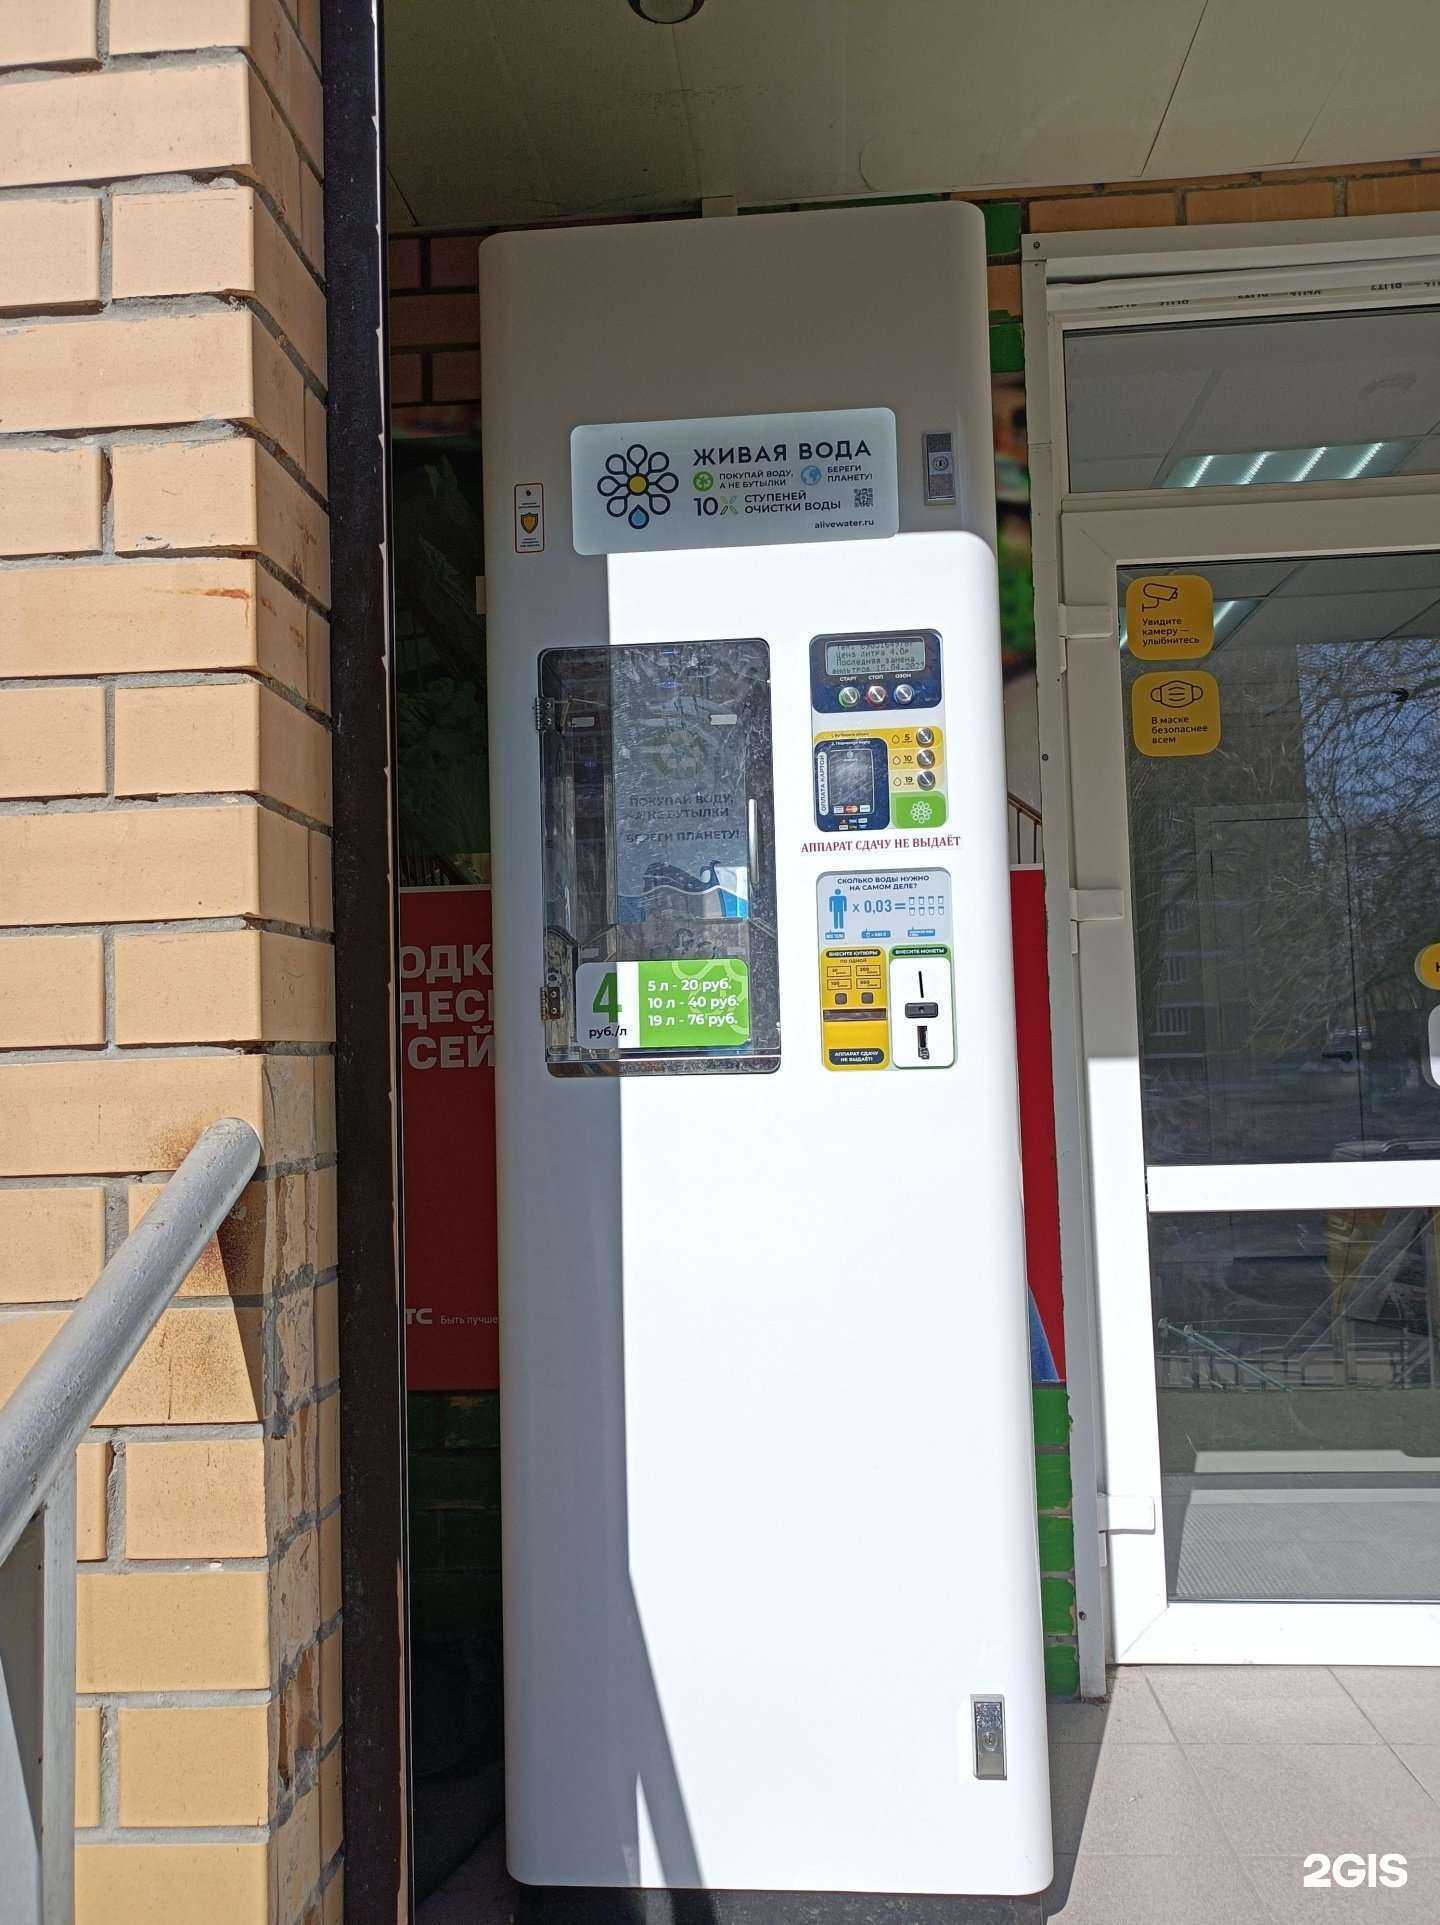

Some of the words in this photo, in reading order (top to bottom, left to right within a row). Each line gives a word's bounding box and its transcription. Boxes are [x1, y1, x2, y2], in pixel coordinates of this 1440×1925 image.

[693, 444, 787, 466] ЖИВАЯ
[799, 439, 871, 461] ВОДА
[719, 470, 764, 480] ПОКУПАЙ
[766, 469, 794, 479] ВОДУ,
[827, 464, 862, 474] БЕРЕГИ
[827, 473, 873, 483] ПЛАНЕТУ!
[728, 481, 741, 489] НЕ
[742, 479, 787, 488] БУТЫЛКИ
[744, 490, 807, 503] СТУПЕНЕЙ
[744, 501, 801, 514] ОЧИСТКИ
[804, 500, 841, 511] ВОДЫ
[814, 518, 875, 529] alivewater.ru
[1142, 618, 1182, 627] Увидите
[1142, 628, 1178, 637] камеру
[1142, 636, 1200, 647] улыбнитесь
[1151, 716, 1158, 724] В
[1160, 715, 1189, 724] маске
[1151, 725, 1208, 735] безопаснее
[904, 733, 910, 741] 5
[1152, 736, 1176, 744] всем
[676, 830, 740, 841] ПЛАНЕТУ!
[801, 840, 853, 853] АППАРАТ
[855, 839, 891, 851] СДАЧУ
[894, 838, 910, 849] НЕ
[912, 835, 961, 848] ВЫДАЁТ
[837, 877, 874, 885] СКОЛЬКО
[892, 883, 918, 891] ДЕЛЕ?
[864, 899, 892, 914] 0,03
[648, 980, 656, 991] 5
[659, 982, 669, 991] л
[681, 979, 699, 991] 20
[702, 977, 732, 993] руб.
[592, 972, 623, 1023] 4
[648, 997, 663, 1009] 10
[666, 999, 675, 1008] л
[687, 996, 707, 1008] 40
[710, 995, 740, 1010] руб.
[648, 1014, 663, 1026] 19
[665, 1016, 675, 1026] л
[688, 1013, 705, 1026] 76
[708, 1012, 738, 1028] руб.
[588, 1026, 628, 1039] руб./л
[440, 1314, 465, 1325] Быть
